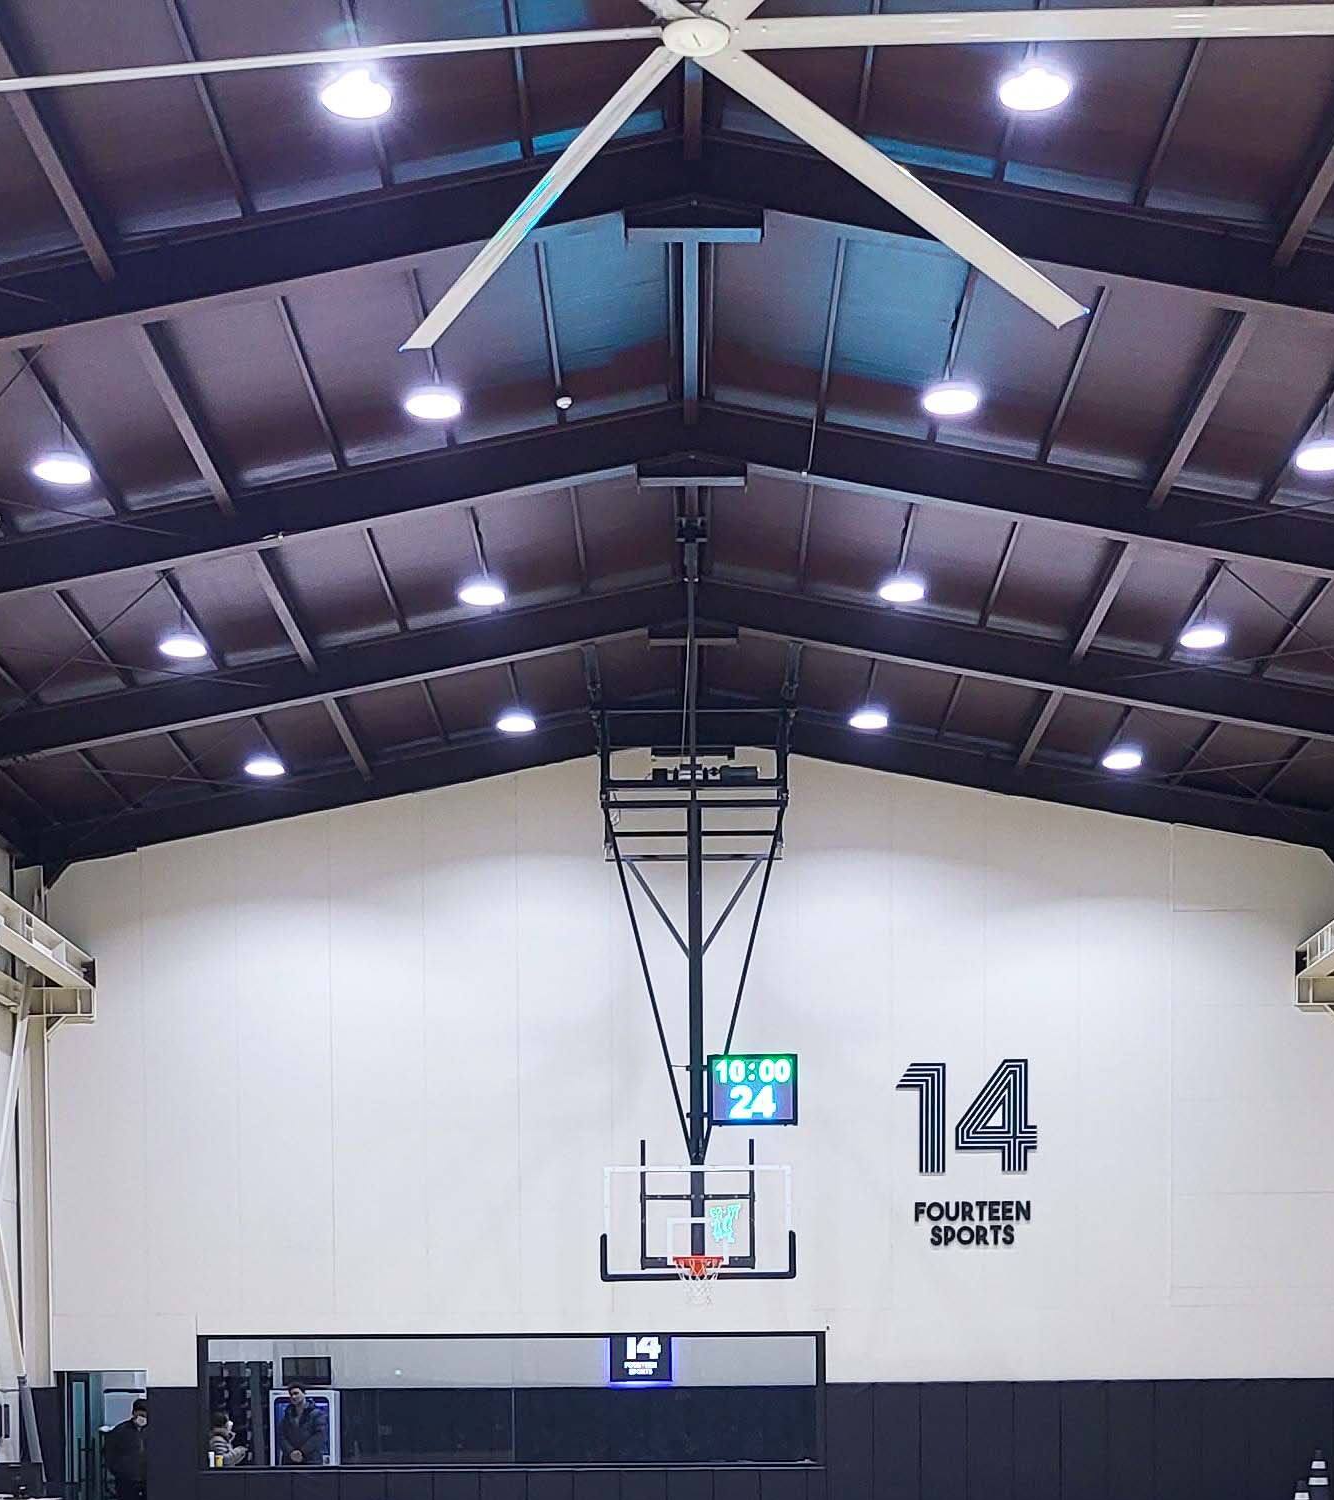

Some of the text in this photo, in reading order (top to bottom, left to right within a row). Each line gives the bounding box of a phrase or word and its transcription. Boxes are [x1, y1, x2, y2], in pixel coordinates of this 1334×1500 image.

[716, 1058, 792, 1084] 10:00
[728, 1084, 778, 1120] 24
[896, 1058, 1038, 1174] 14
[914, 1200, 1032, 1223] FOURTEEN
[930, 1224, 1016, 1247] SPORTS
[626, 1336, 662, 1360] 14
